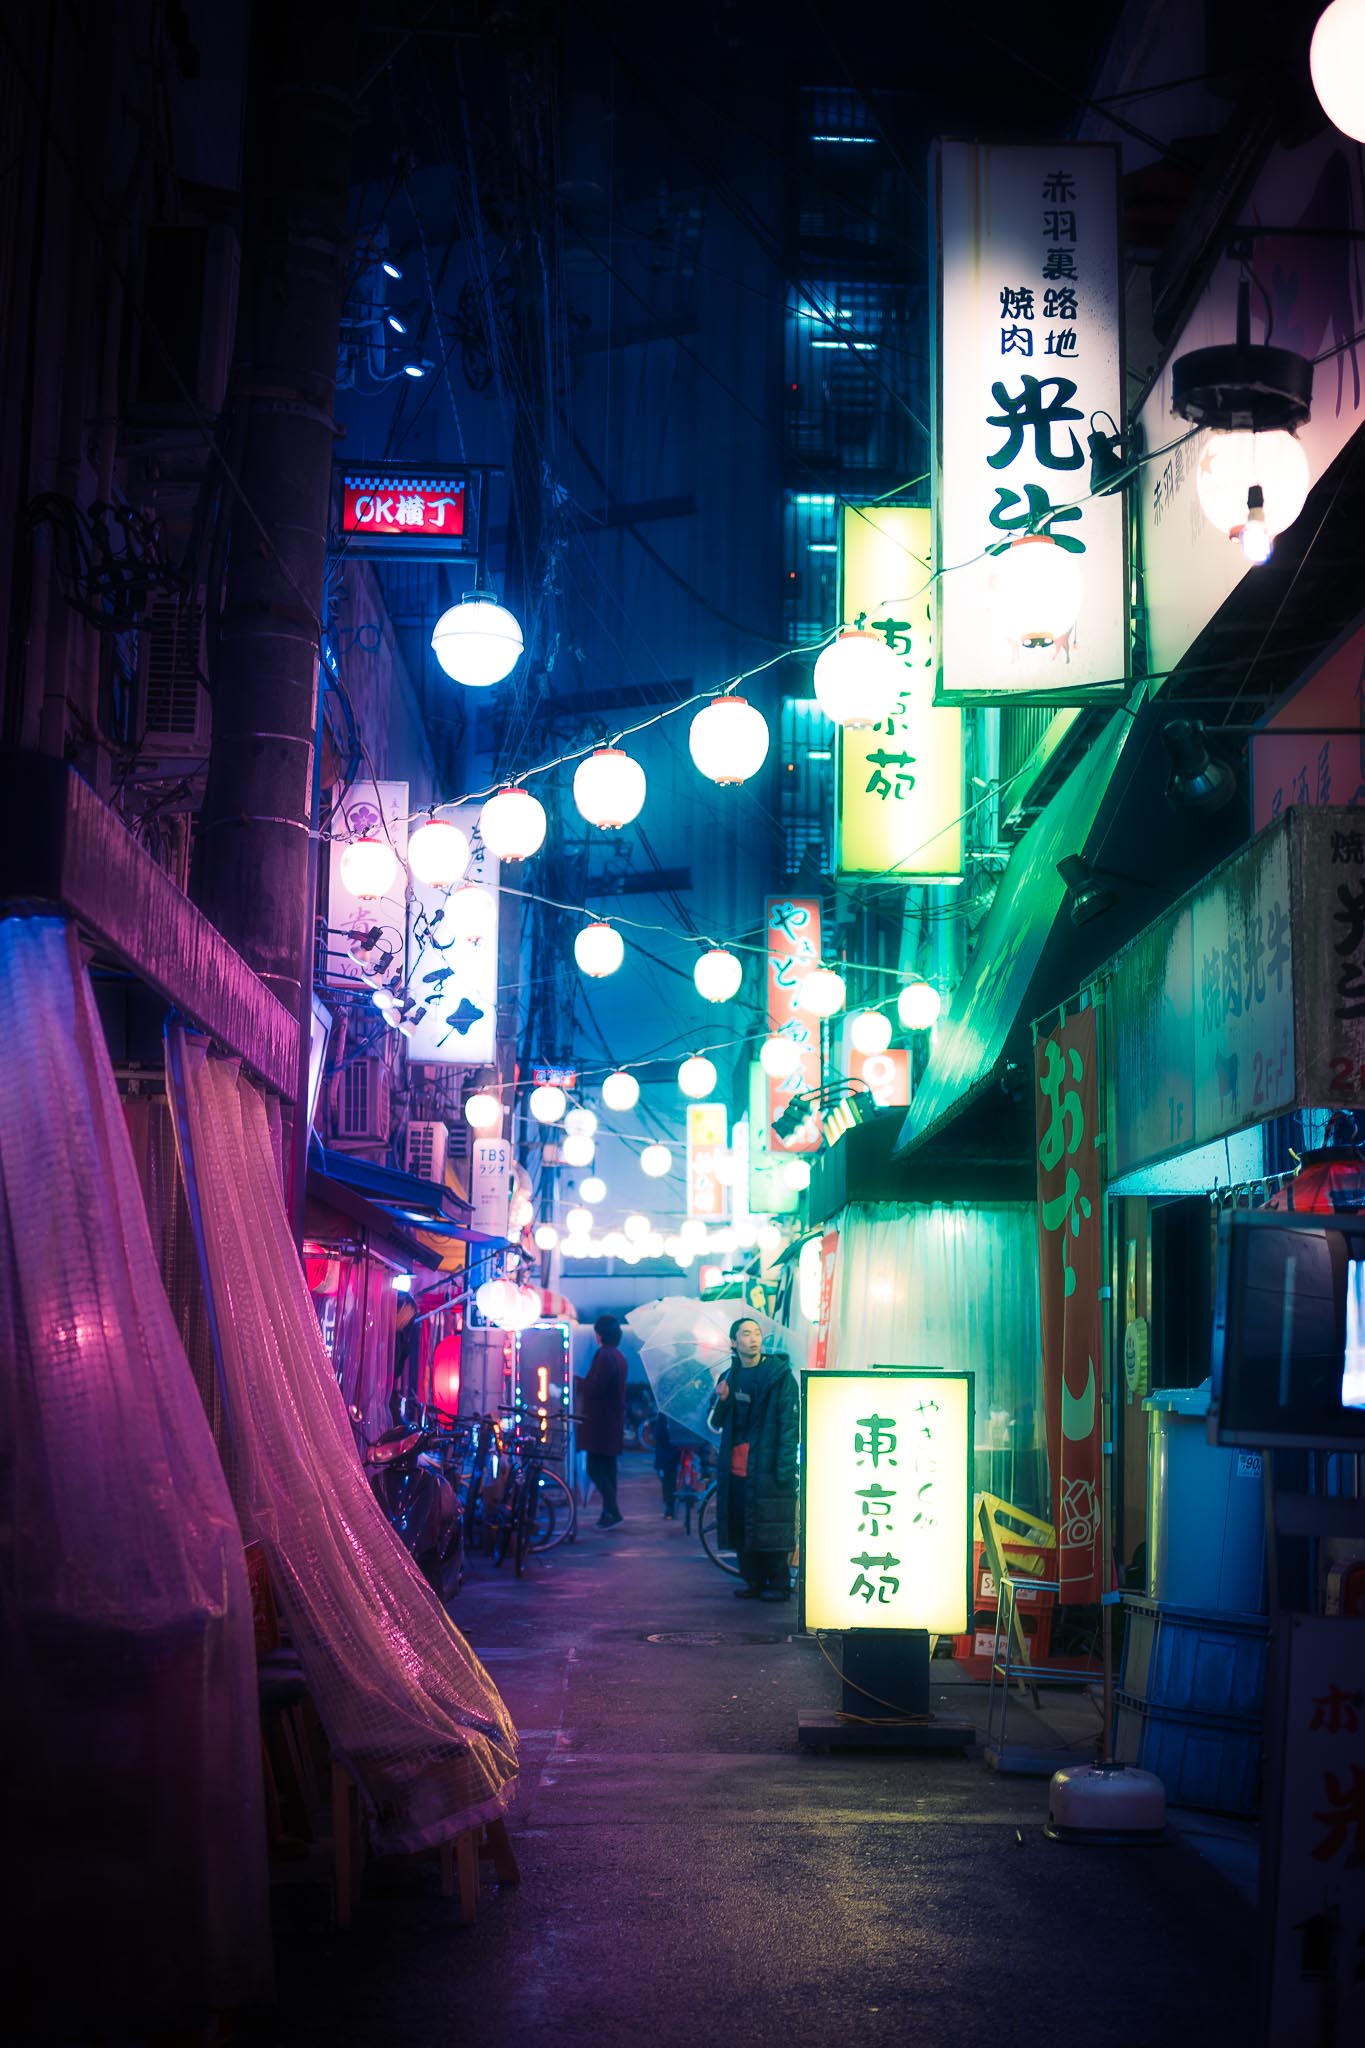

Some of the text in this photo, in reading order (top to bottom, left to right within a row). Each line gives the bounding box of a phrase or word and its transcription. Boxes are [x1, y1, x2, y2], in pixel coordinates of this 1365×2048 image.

[1042, 170, 1080, 358] 赤羽裏路地
[999, 286, 1035, 358] 焼肉
[355, 494, 457, 527] OK横丁
[480, 1149, 505, 1162] TBS
[848, 1413, 901, 1604] 東京苑
